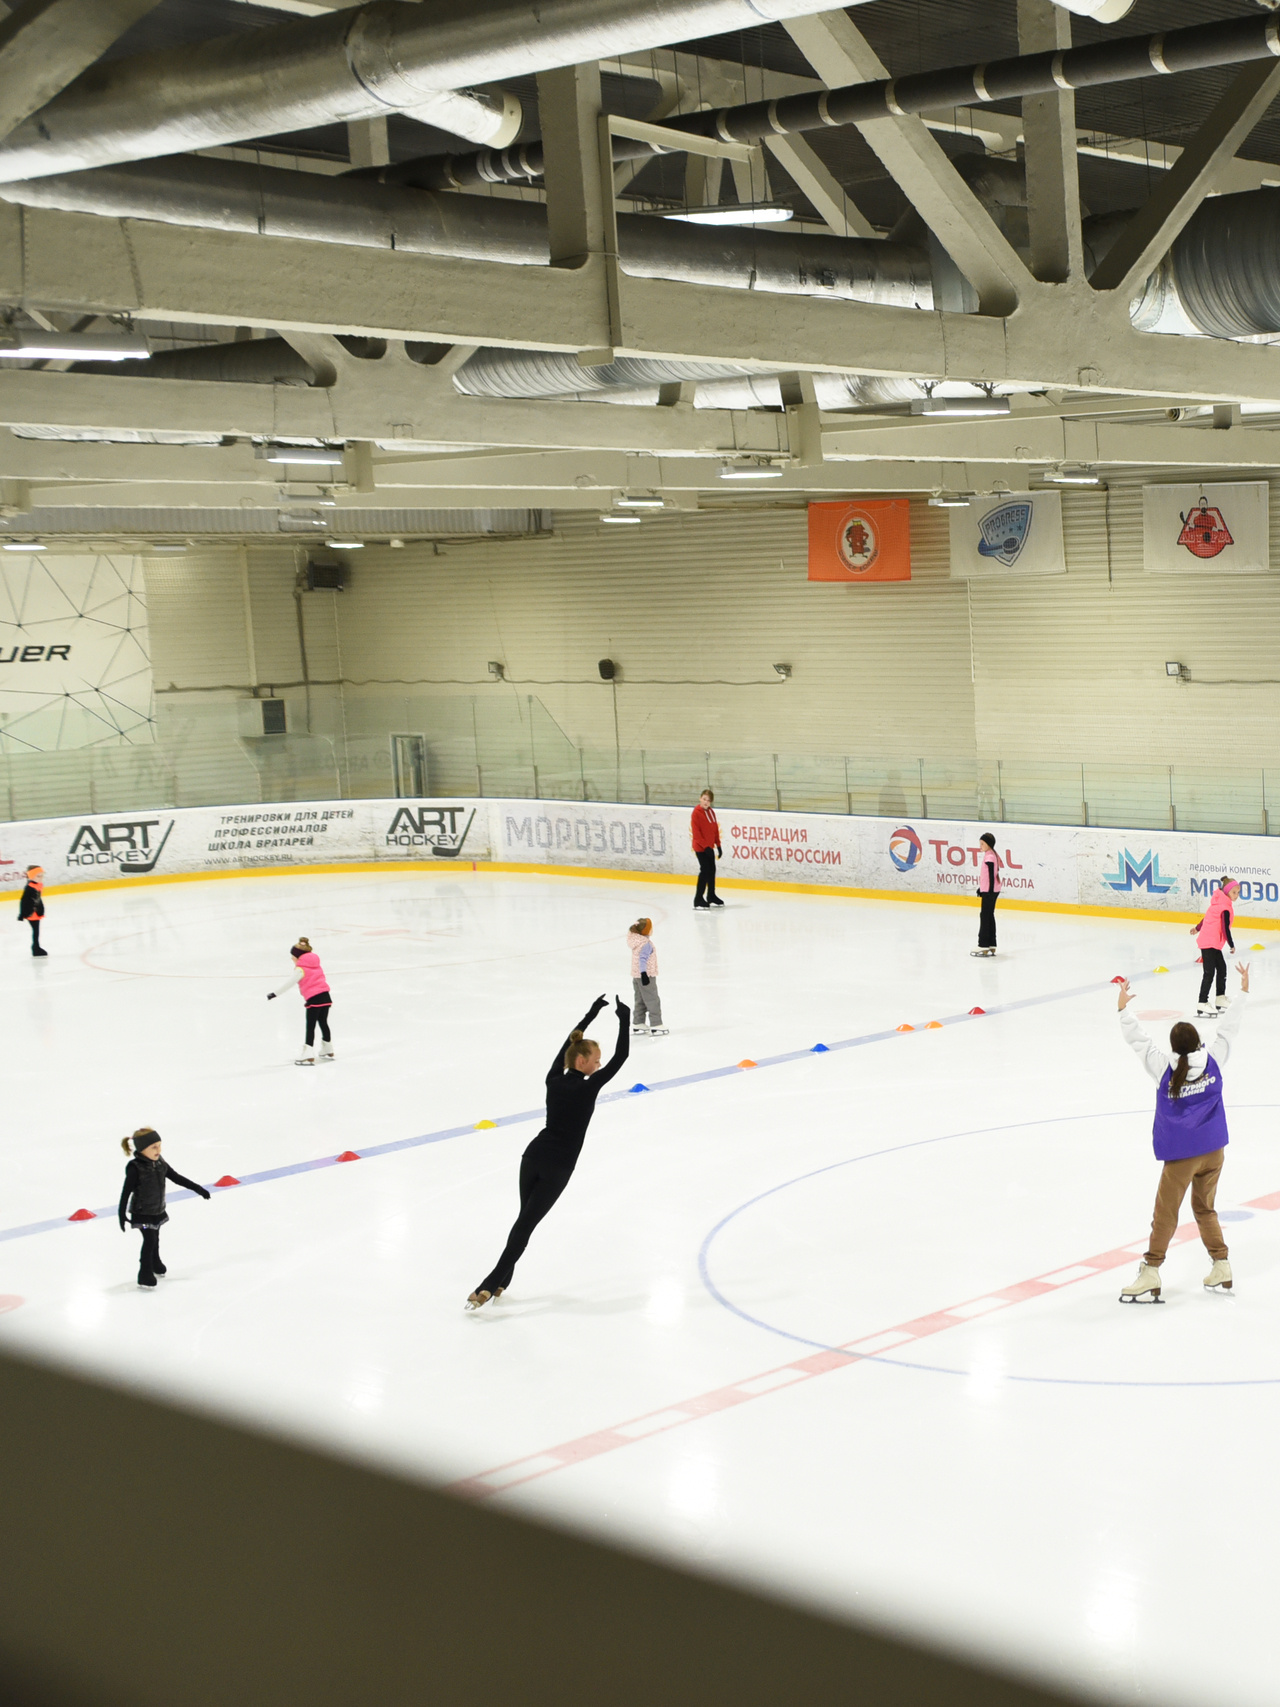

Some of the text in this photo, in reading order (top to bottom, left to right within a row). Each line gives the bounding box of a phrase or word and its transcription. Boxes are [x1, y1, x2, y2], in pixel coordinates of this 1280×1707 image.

[985, 508, 1026, 535] PROGRESS
[221, 809, 354, 825] ТРЕНИРОВКИ ДЛЯ ДЕТЕЙ
[387, 807, 464, 834] ART
[68, 820, 159, 854] ART
[214, 824, 328, 838] ПРОФЕССИОНАЛОВ
[506, 816, 667, 856] МОРОЗОВО
[731, 825, 808, 844] ФЕДЕРАЦИЯ
[208, 836, 314, 851] ШКОЛА ВРАТАРЕЙ
[386, 835, 459, 846] HOCKEY
[66, 849, 152, 867] HOCKEY
[732, 845, 841, 865] ХОККЕЯ РОССИИ
[1189, 863, 1271, 876] ледовый комплекс
[936, 873, 980, 885] МОТОРН
